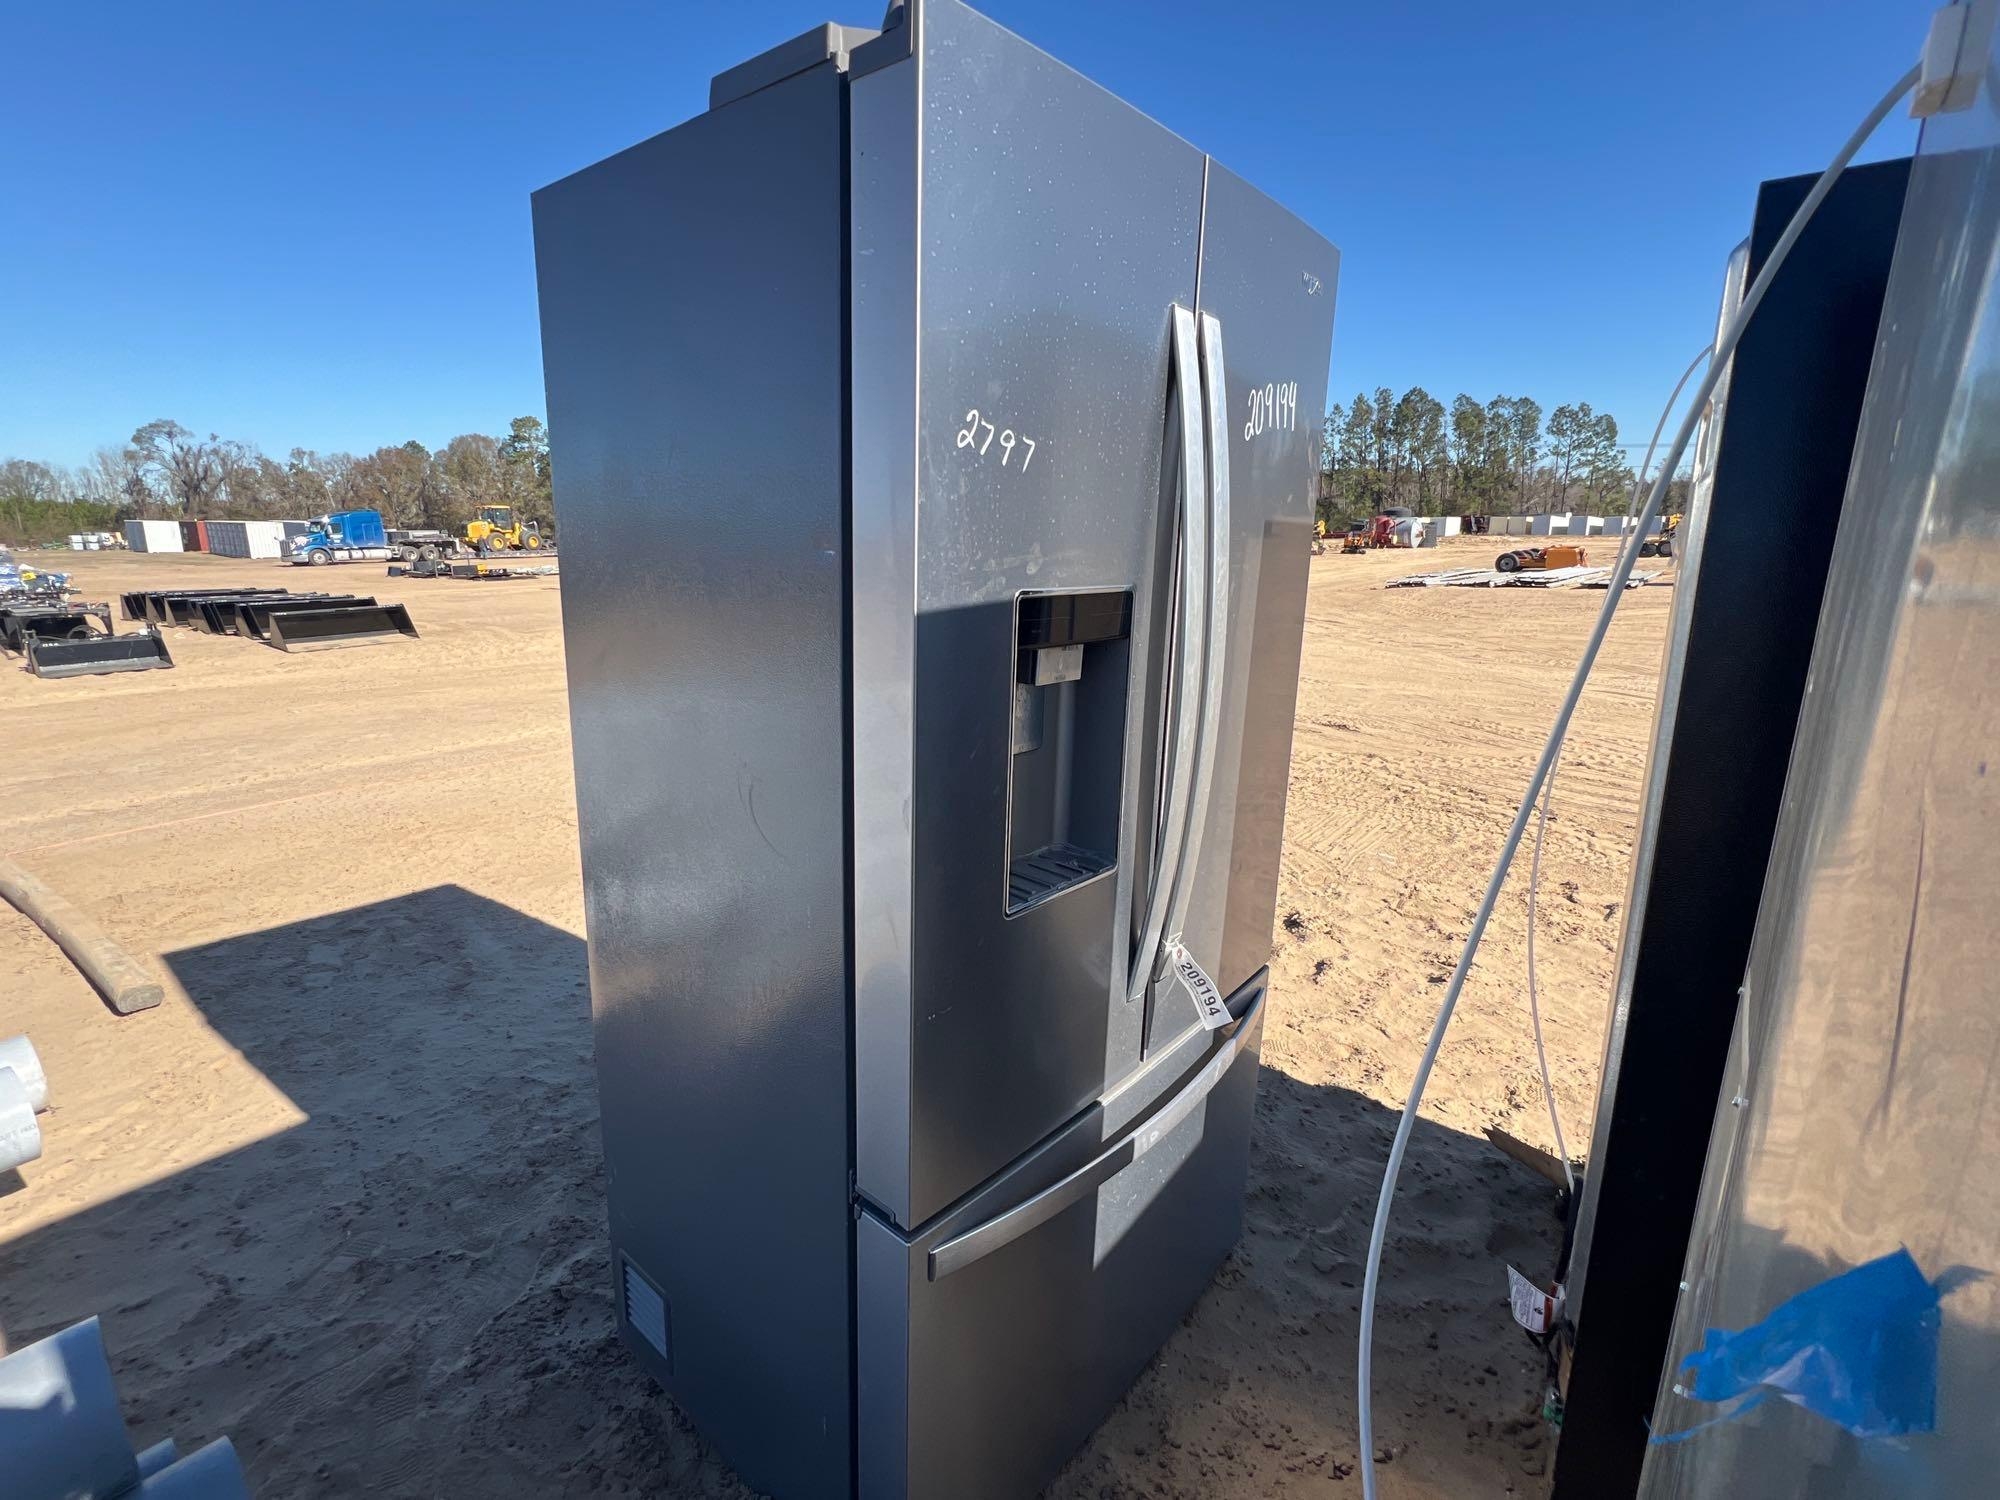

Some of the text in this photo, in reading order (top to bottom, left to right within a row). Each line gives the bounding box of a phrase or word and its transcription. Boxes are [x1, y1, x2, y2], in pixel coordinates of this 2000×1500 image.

[957, 409, 1036, 473] 2797
[1244, 381, 1298, 441] 209194
[1180, 962, 1221, 1017] 209194
